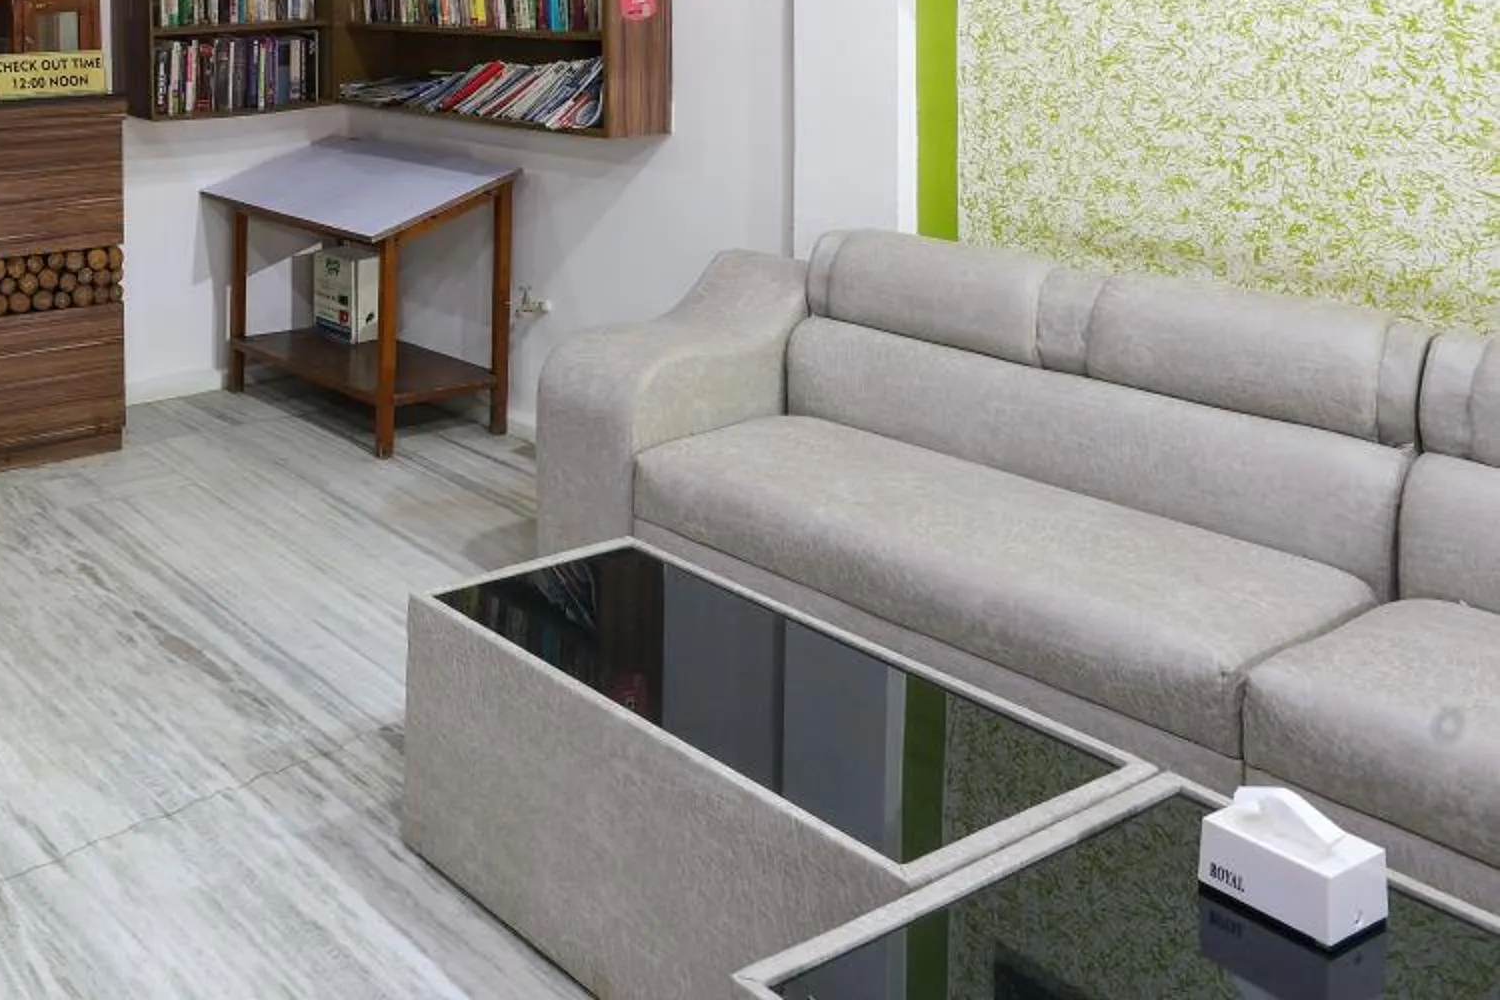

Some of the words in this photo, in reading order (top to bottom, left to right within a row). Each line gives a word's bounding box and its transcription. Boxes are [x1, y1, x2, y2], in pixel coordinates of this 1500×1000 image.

[41, 58, 67, 71] OUT
[72, 57, 101, 69] TIME
[12, 77, 46, 89] 12:00
[49, 75, 89, 87] NOON
[1209, 862, 1245, 893] ROYAL
